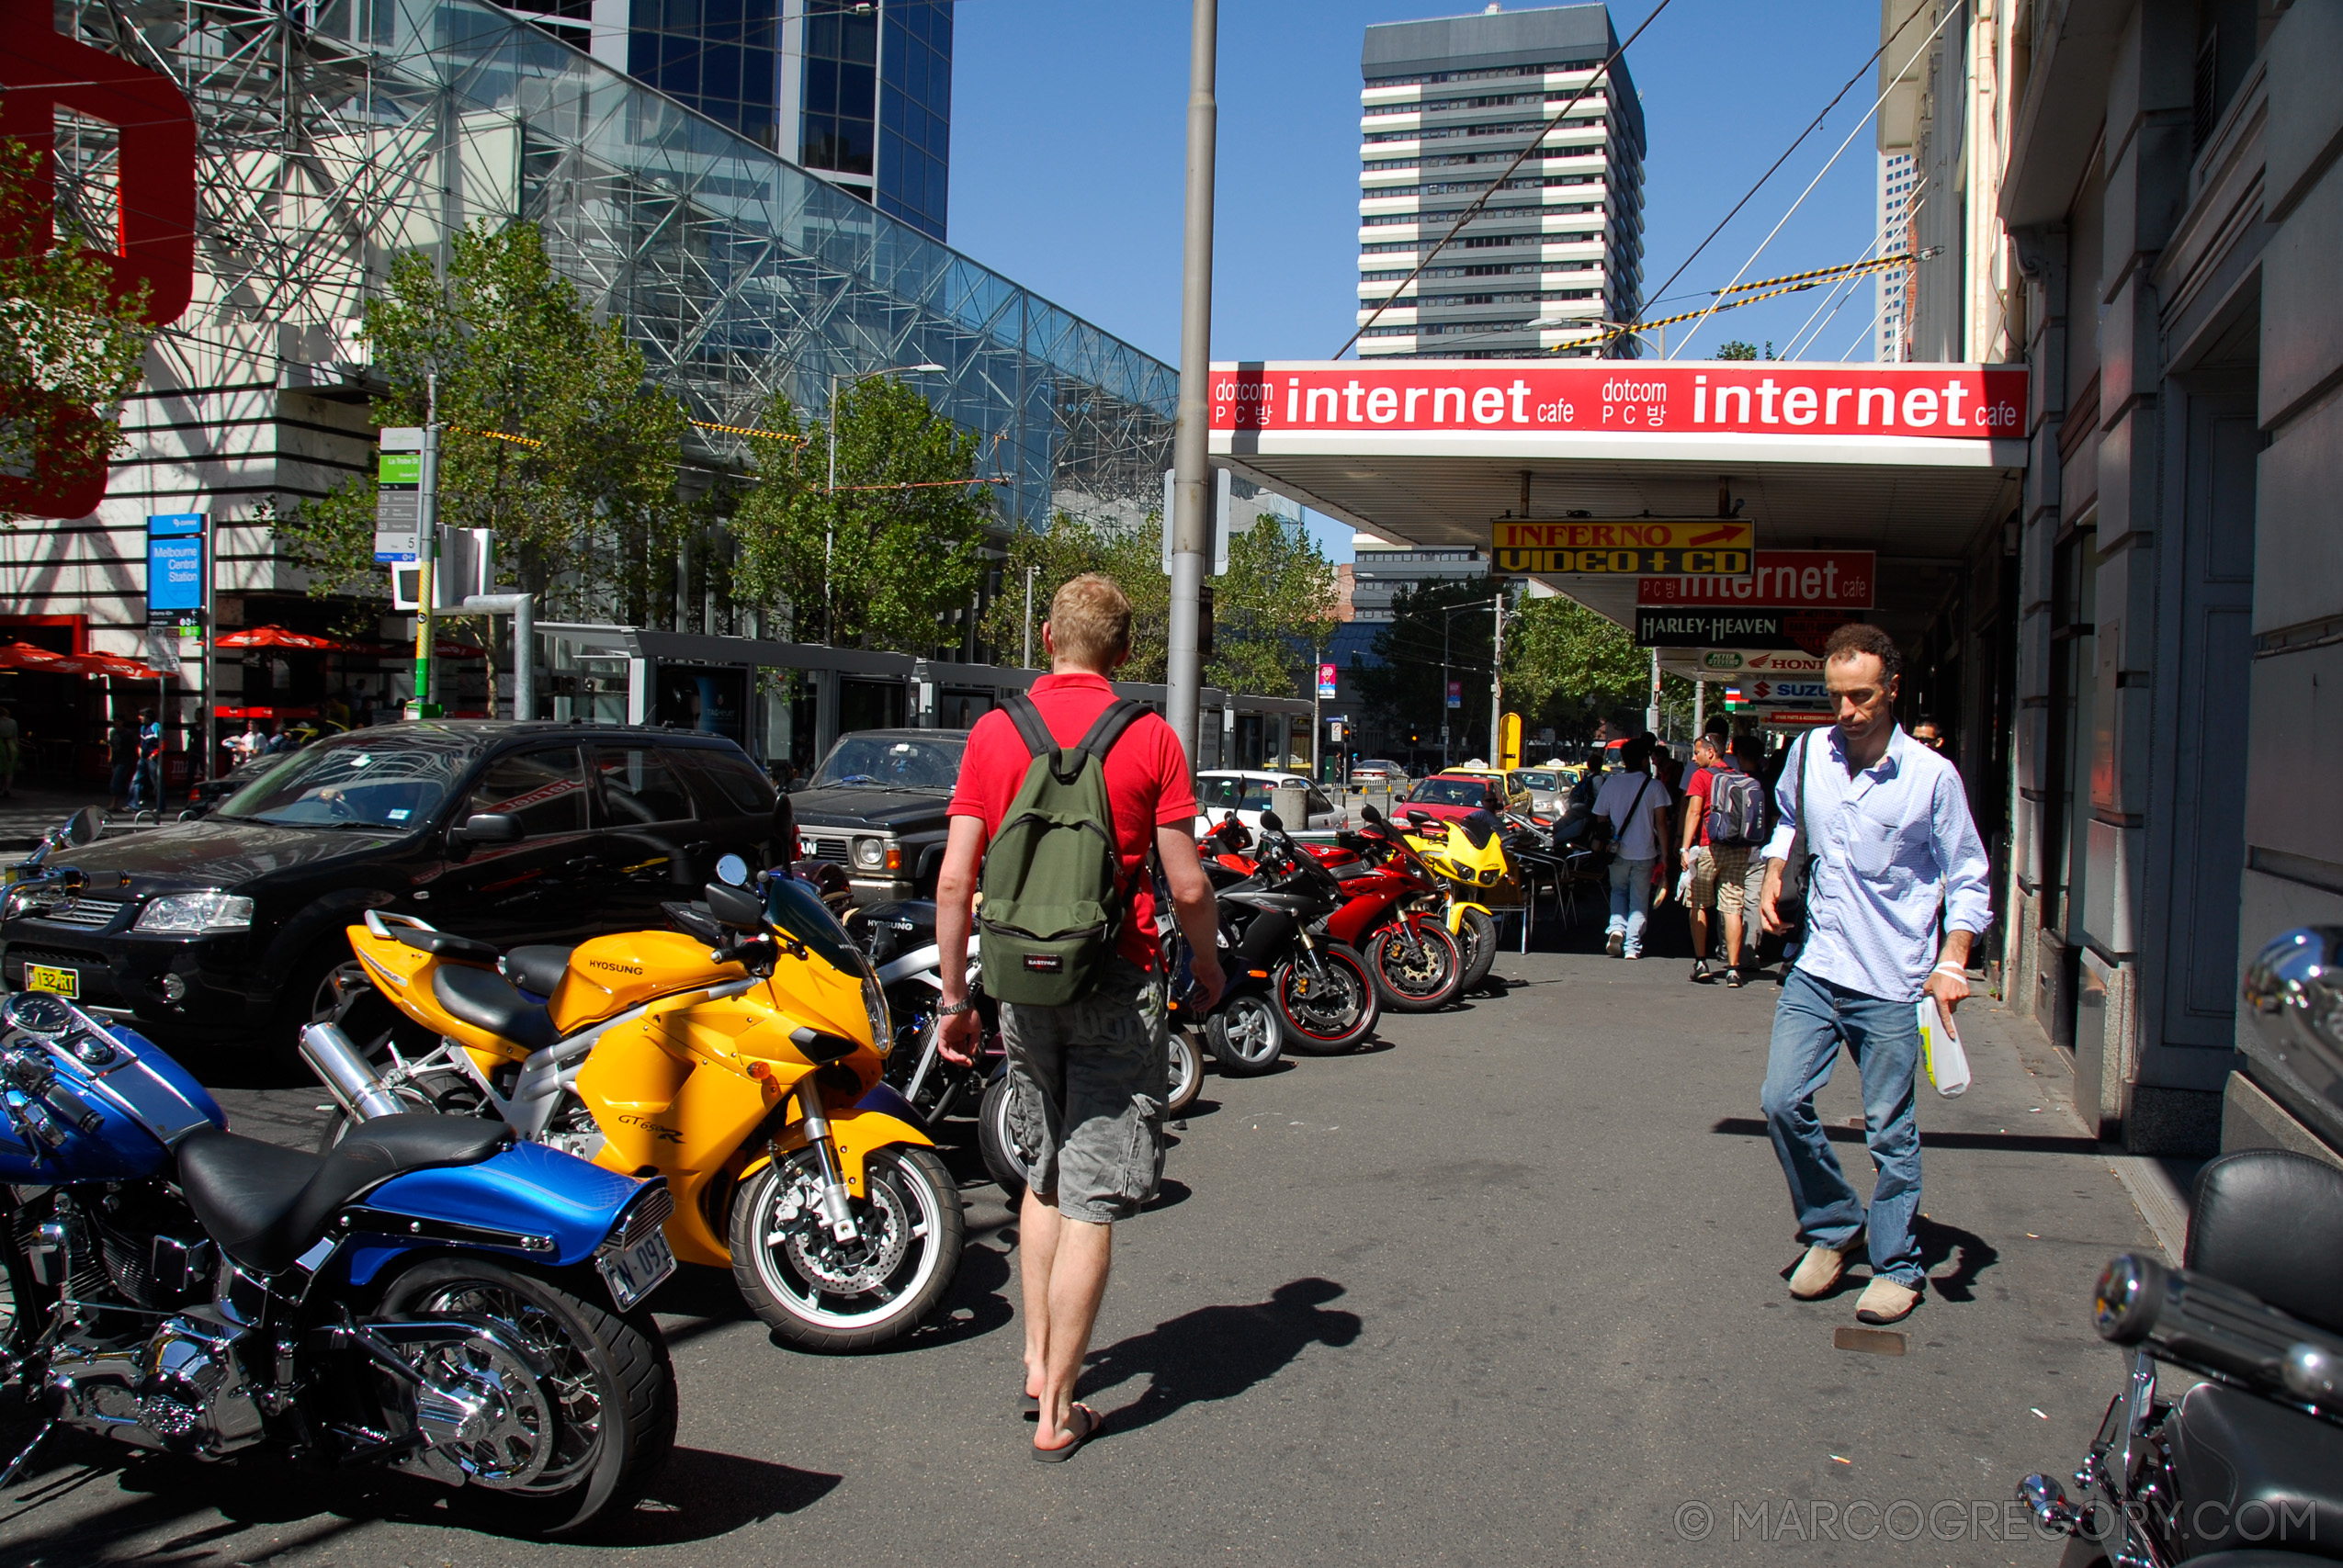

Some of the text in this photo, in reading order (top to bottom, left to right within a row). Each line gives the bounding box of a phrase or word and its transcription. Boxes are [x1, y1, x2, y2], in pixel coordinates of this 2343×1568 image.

[1215, 378, 1273, 402] dotcom
[1602, 378, 1667, 402] dotcom
[1286, 378, 1574, 423] internet cafe
[1693, 375, 2016, 427] internet cafe
[380, 495, 389, 503] 19
[379, 508, 388, 517] 57
[378, 522, 387, 530] 59
[408, 537, 415, 549] 5
[1506, 525, 1672, 547] INFERNO
[153, 547, 198, 558] Melbourne
[168, 559, 198, 570] Central
[1500, 550, 1639, 572] VIDEO
[1681, 551, 1747, 573] CD
[168, 571, 198, 582] Station
[1842, 577, 1866, 598] cafe
[1642, 617, 1776, 641] HARLEY-HEAVEN
[867, 919, 913, 931] HYOSUNG
[589, 959, 644, 976] HYOSUNG
